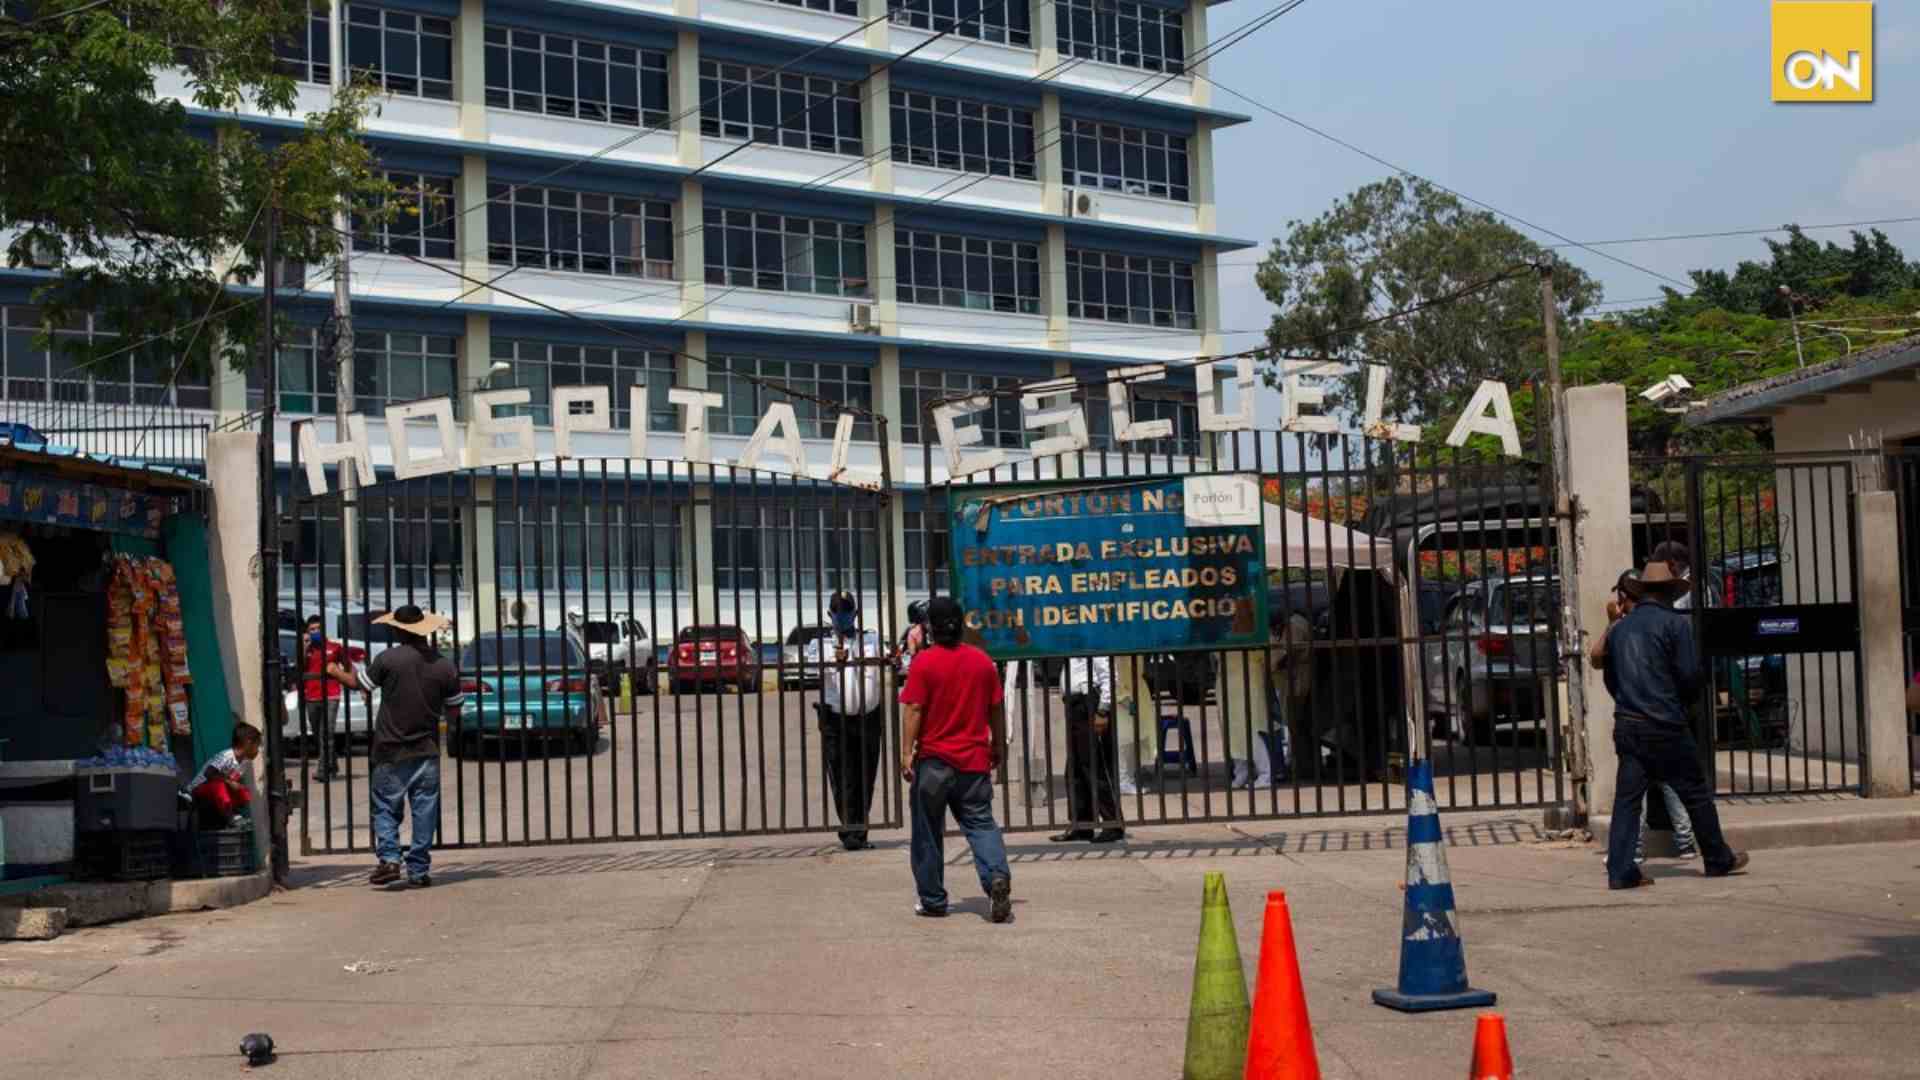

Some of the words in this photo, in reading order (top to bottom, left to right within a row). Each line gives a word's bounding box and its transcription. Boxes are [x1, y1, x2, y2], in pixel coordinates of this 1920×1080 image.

[298, 384, 891, 496] HOSPITAL
[931, 356, 1522, 478] ESCUELA
[963, 541, 1093, 567] ENTRADA
[1101, 534, 1254, 561] EXCLUSIVA
[991, 574, 1063, 596] PARA
[1071, 566, 1237, 594] EMPLEADOS
[964, 607, 1023, 630] CON
